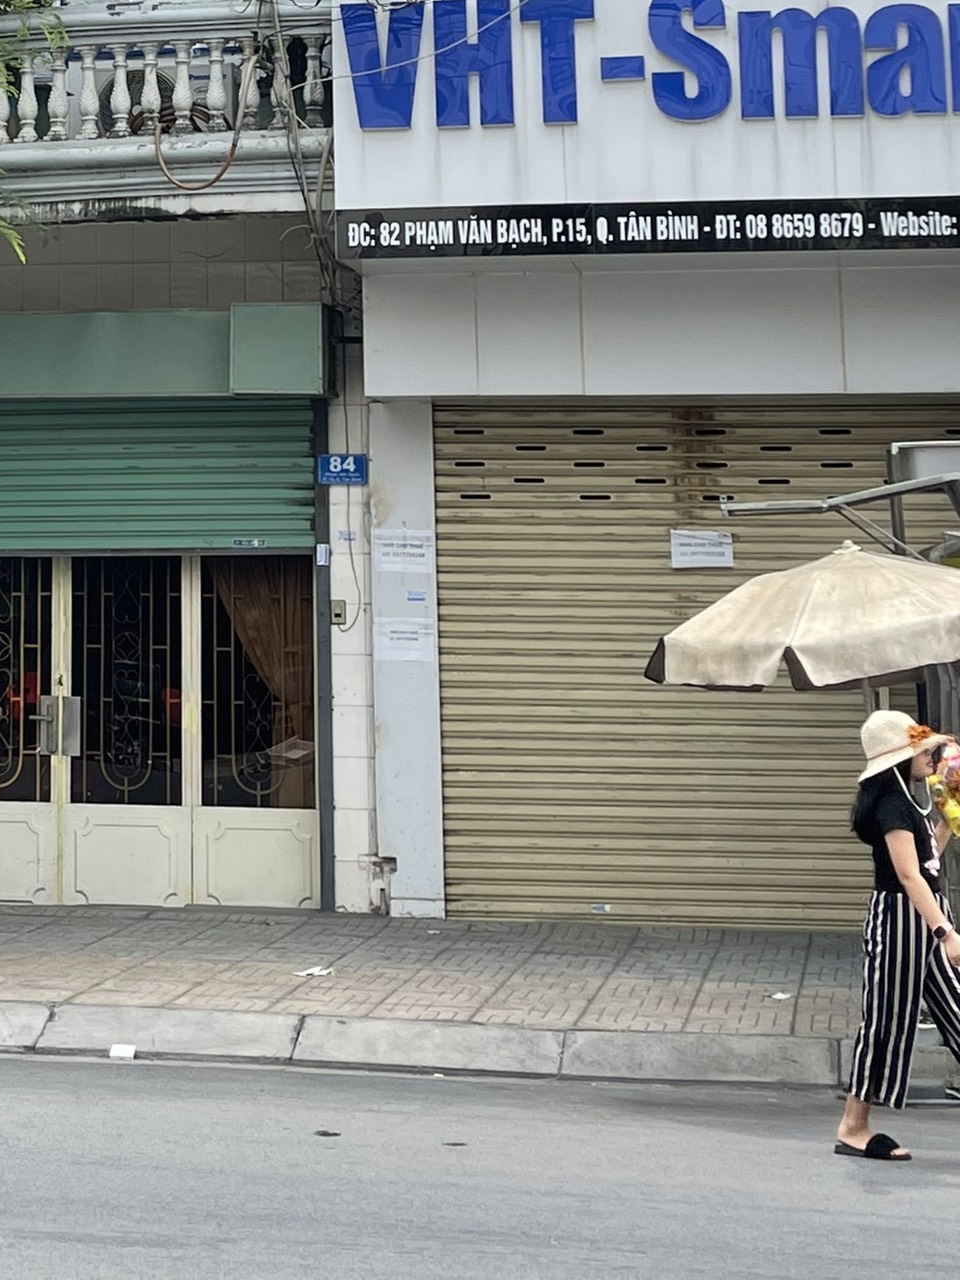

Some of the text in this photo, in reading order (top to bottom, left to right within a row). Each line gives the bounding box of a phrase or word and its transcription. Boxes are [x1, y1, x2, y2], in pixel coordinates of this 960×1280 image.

[348, 223, 376, 247] ĐC:
[380, 222, 400, 246] 82
[405, 220, 454, 250] PHẠM
[457, 214, 492, 244] VĂN
[497, 218, 548, 248] BẠCH,
[596, 217, 614, 244] Q.
[617, 211, 652, 241] TÂN
[656, 210, 699, 240] BÌNH
[715, 214, 741, 239] ĐT:
[745, 213, 768, 239] 08
[772, 213, 815, 239] 8659
[819, 212, 864, 238] 8679
[880, 210, 958, 237] Website:
[329, 455, 356, 473] 84
